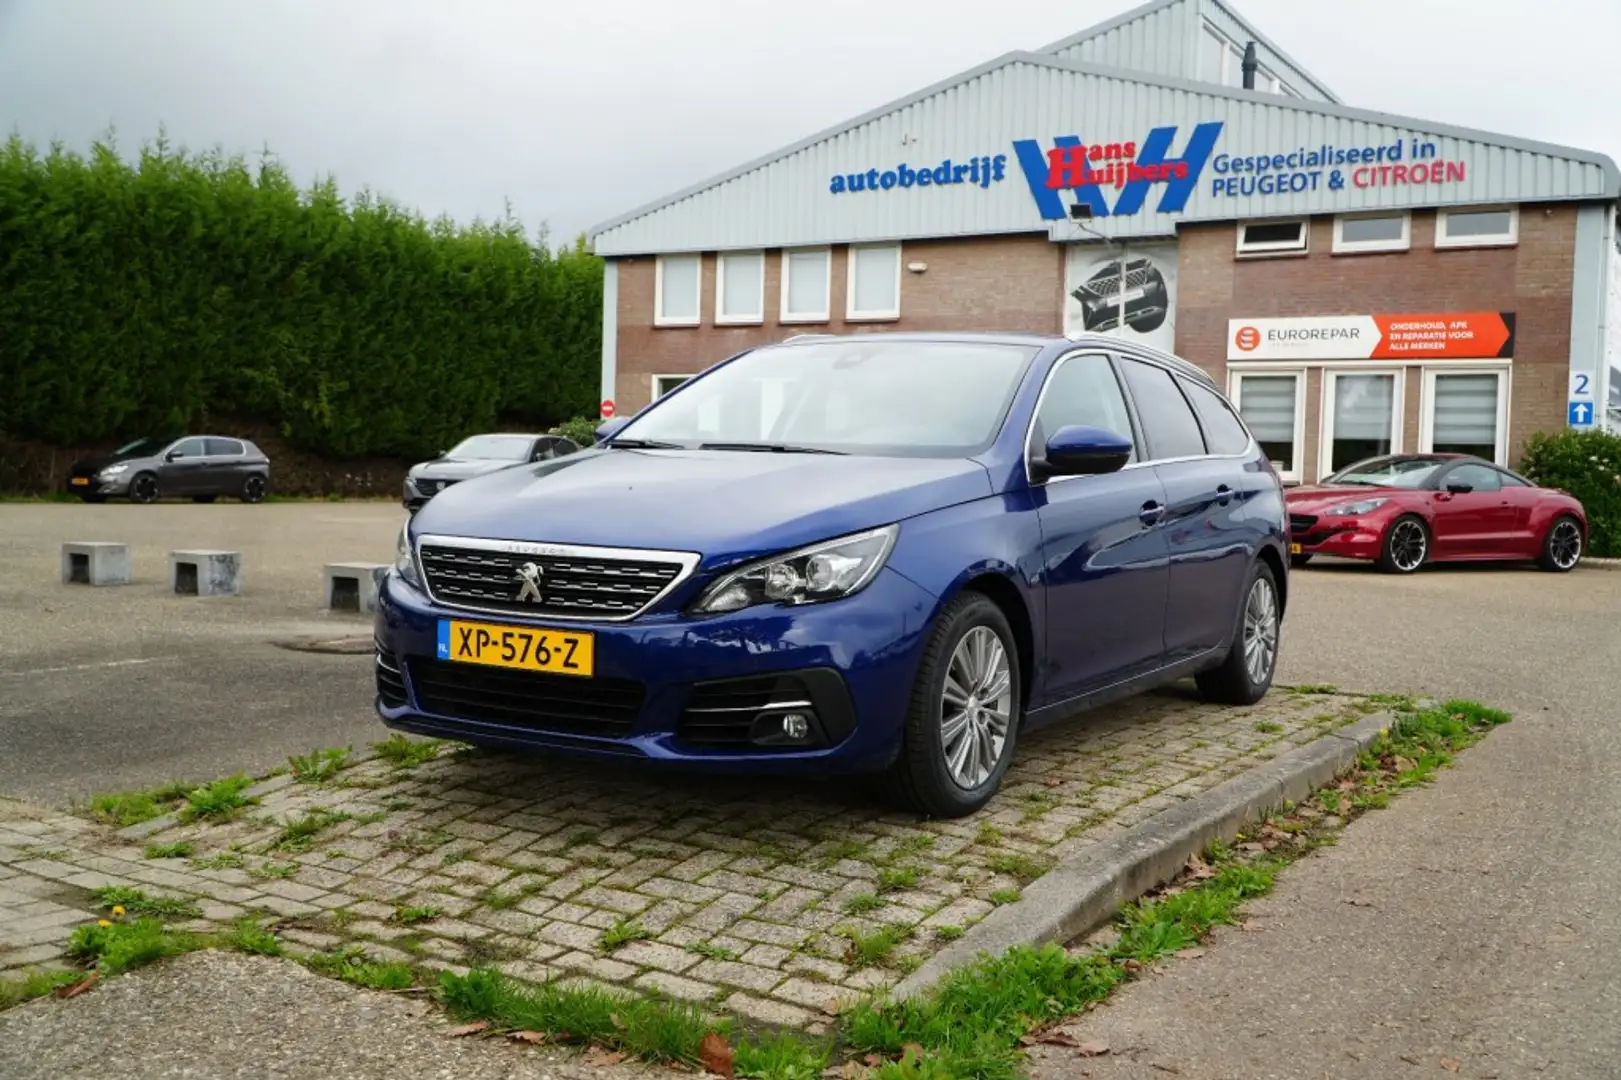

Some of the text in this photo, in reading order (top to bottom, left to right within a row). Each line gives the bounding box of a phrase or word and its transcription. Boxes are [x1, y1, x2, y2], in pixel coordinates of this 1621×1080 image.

[1046, 141, 1136, 189] Hans
[1213, 138, 1436, 176] Gespecialiseerd in
[830, 154, 1006, 194] autobedrijf
[1212, 160, 1466, 197] PEUGEOT & CITROËN
[1267, 328, 1360, 341] EUROREPAR
[1403, 332, 1446, 340] REPARATIE
[1448, 331, 1474, 339] VOOR
[1449, 320, 1468, 329] APK
[1410, 342, 1445, 350] MERKEN
[1574, 374, 1589, 395] 2
[458, 627, 579, 669] XP-576-Z
